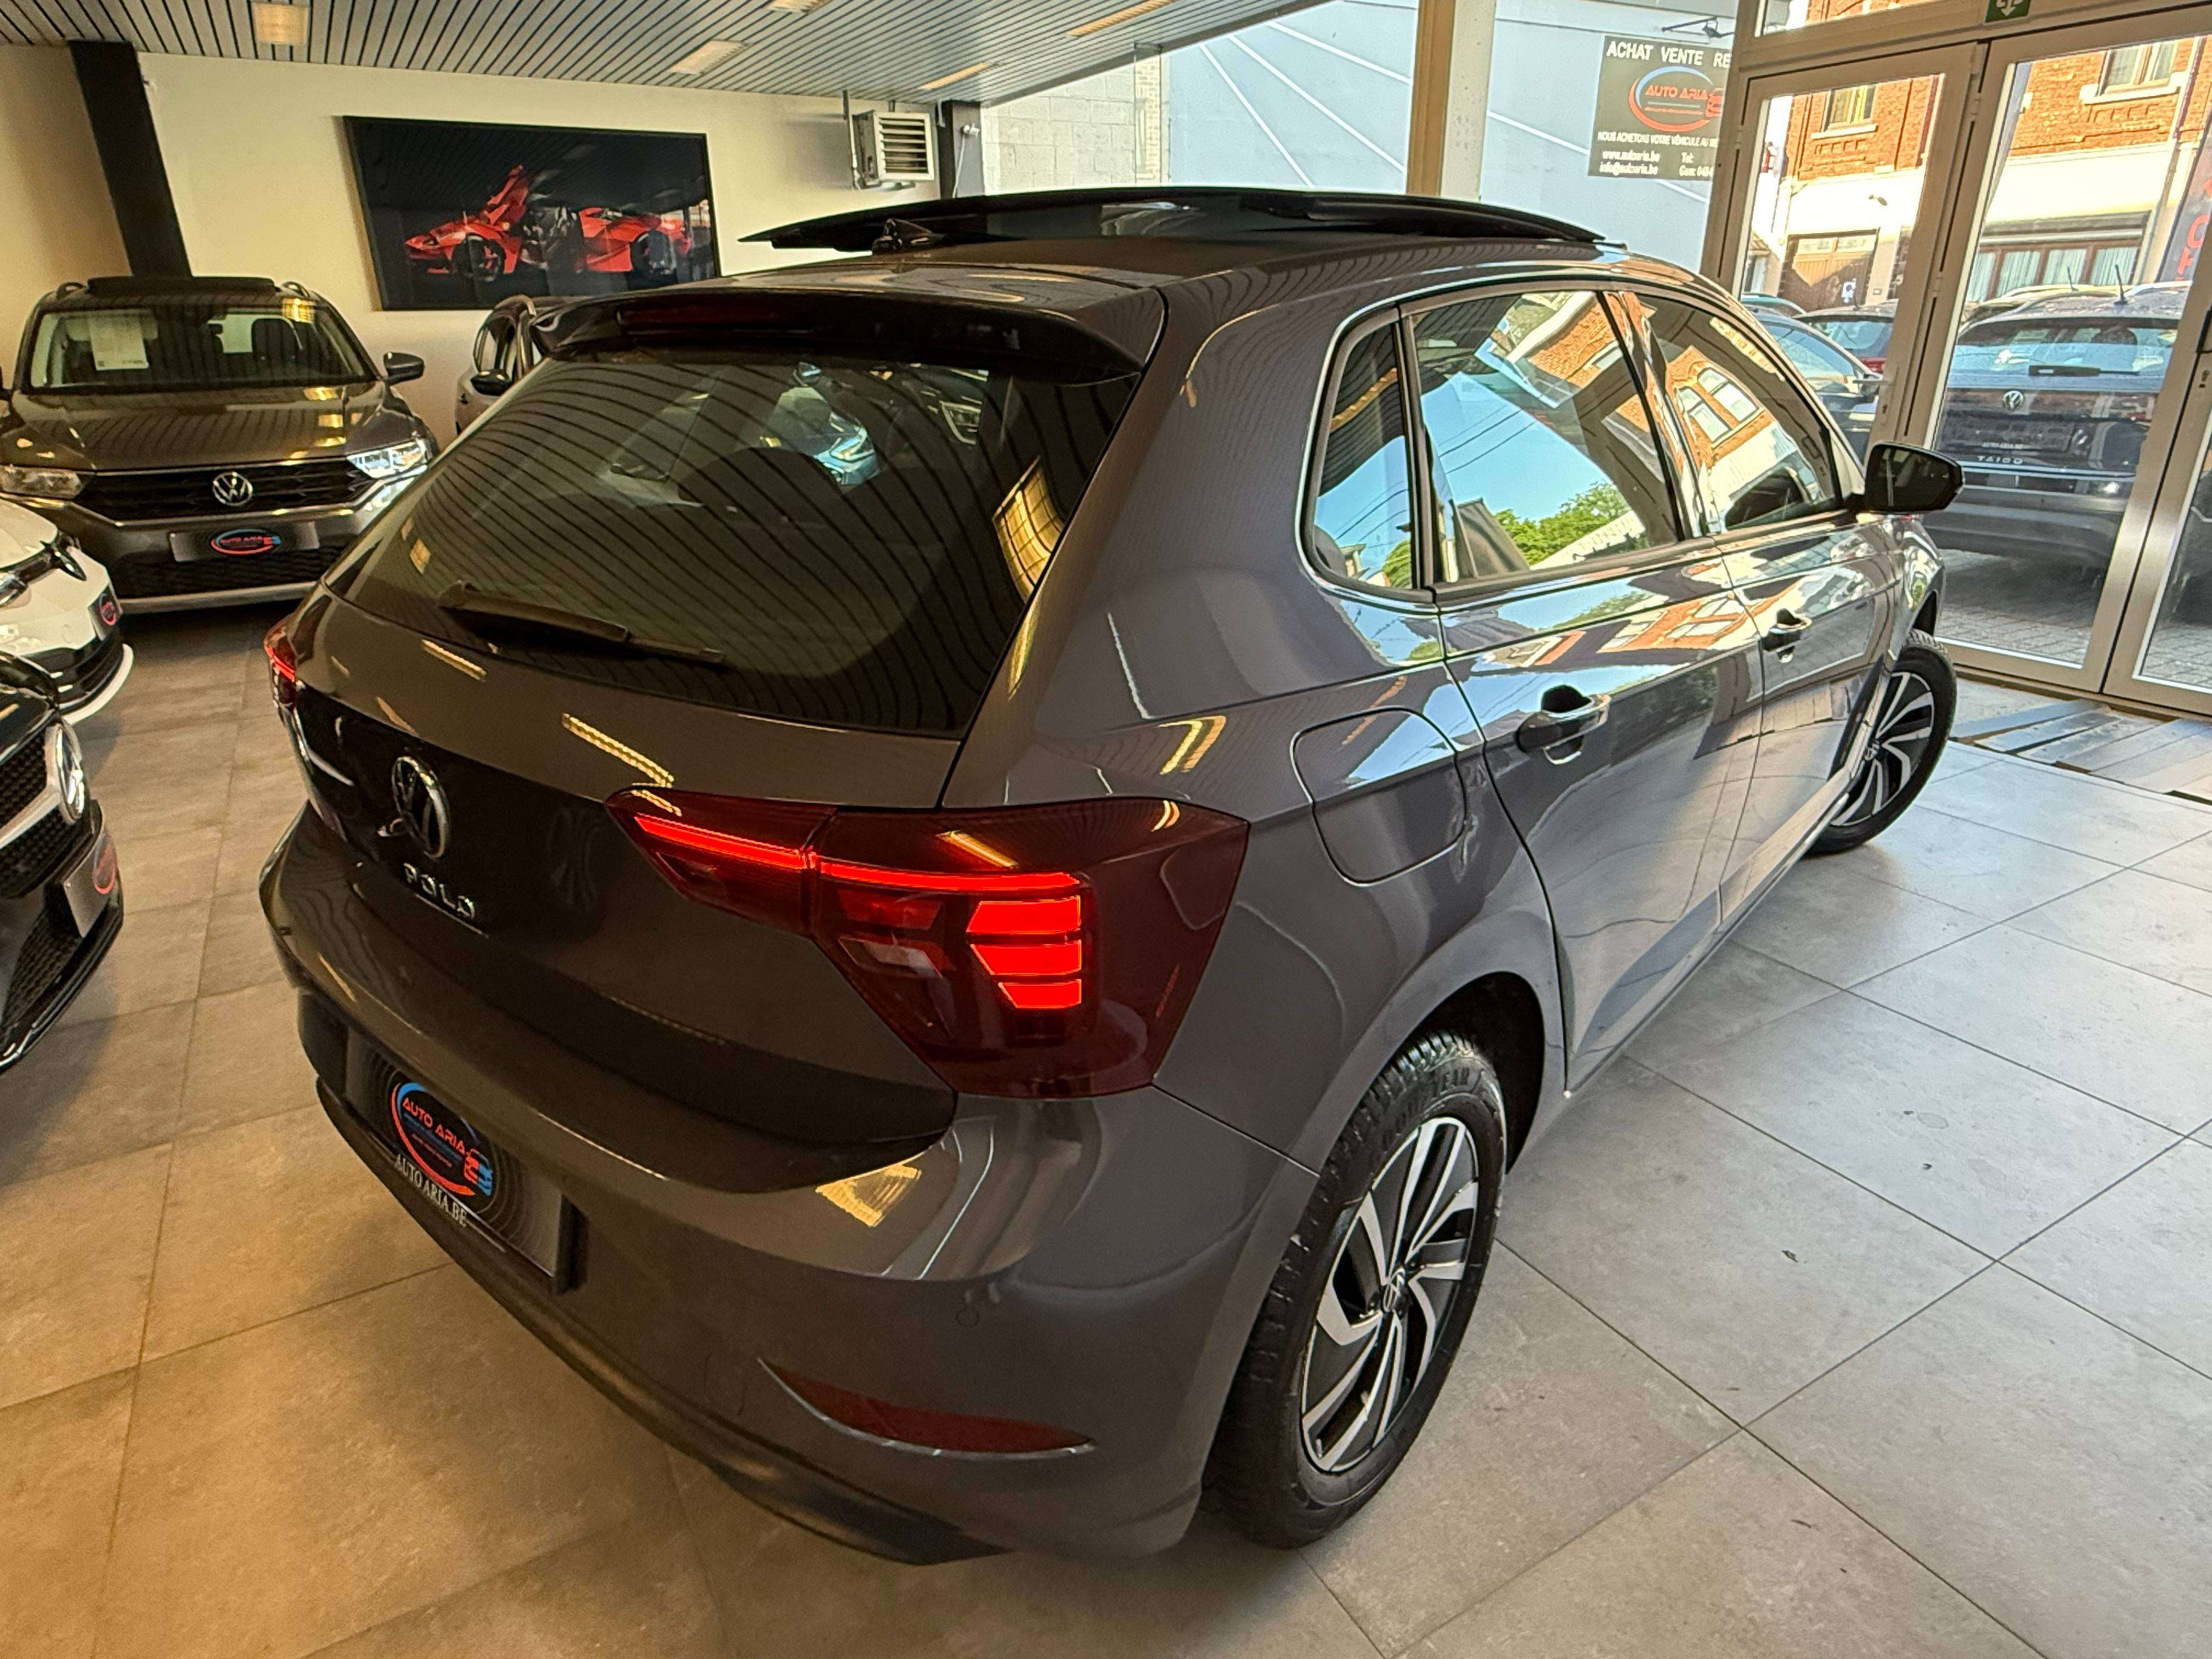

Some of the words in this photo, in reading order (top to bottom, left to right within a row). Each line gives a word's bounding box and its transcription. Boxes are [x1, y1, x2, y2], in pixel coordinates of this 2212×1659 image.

[1606, 41, 1654, 61] ACHAT
[1661, 46, 1703, 66] VENTE
[1645, 85, 1678, 98] AUTO
[1679, 87, 1708, 100] ARIA
[1977, 455, 2023, 464] TAIGO
[403, 862, 476, 919] POLO
[402, 1097, 433, 1128] AUTO
[435, 1124, 466, 1155] ARIA
